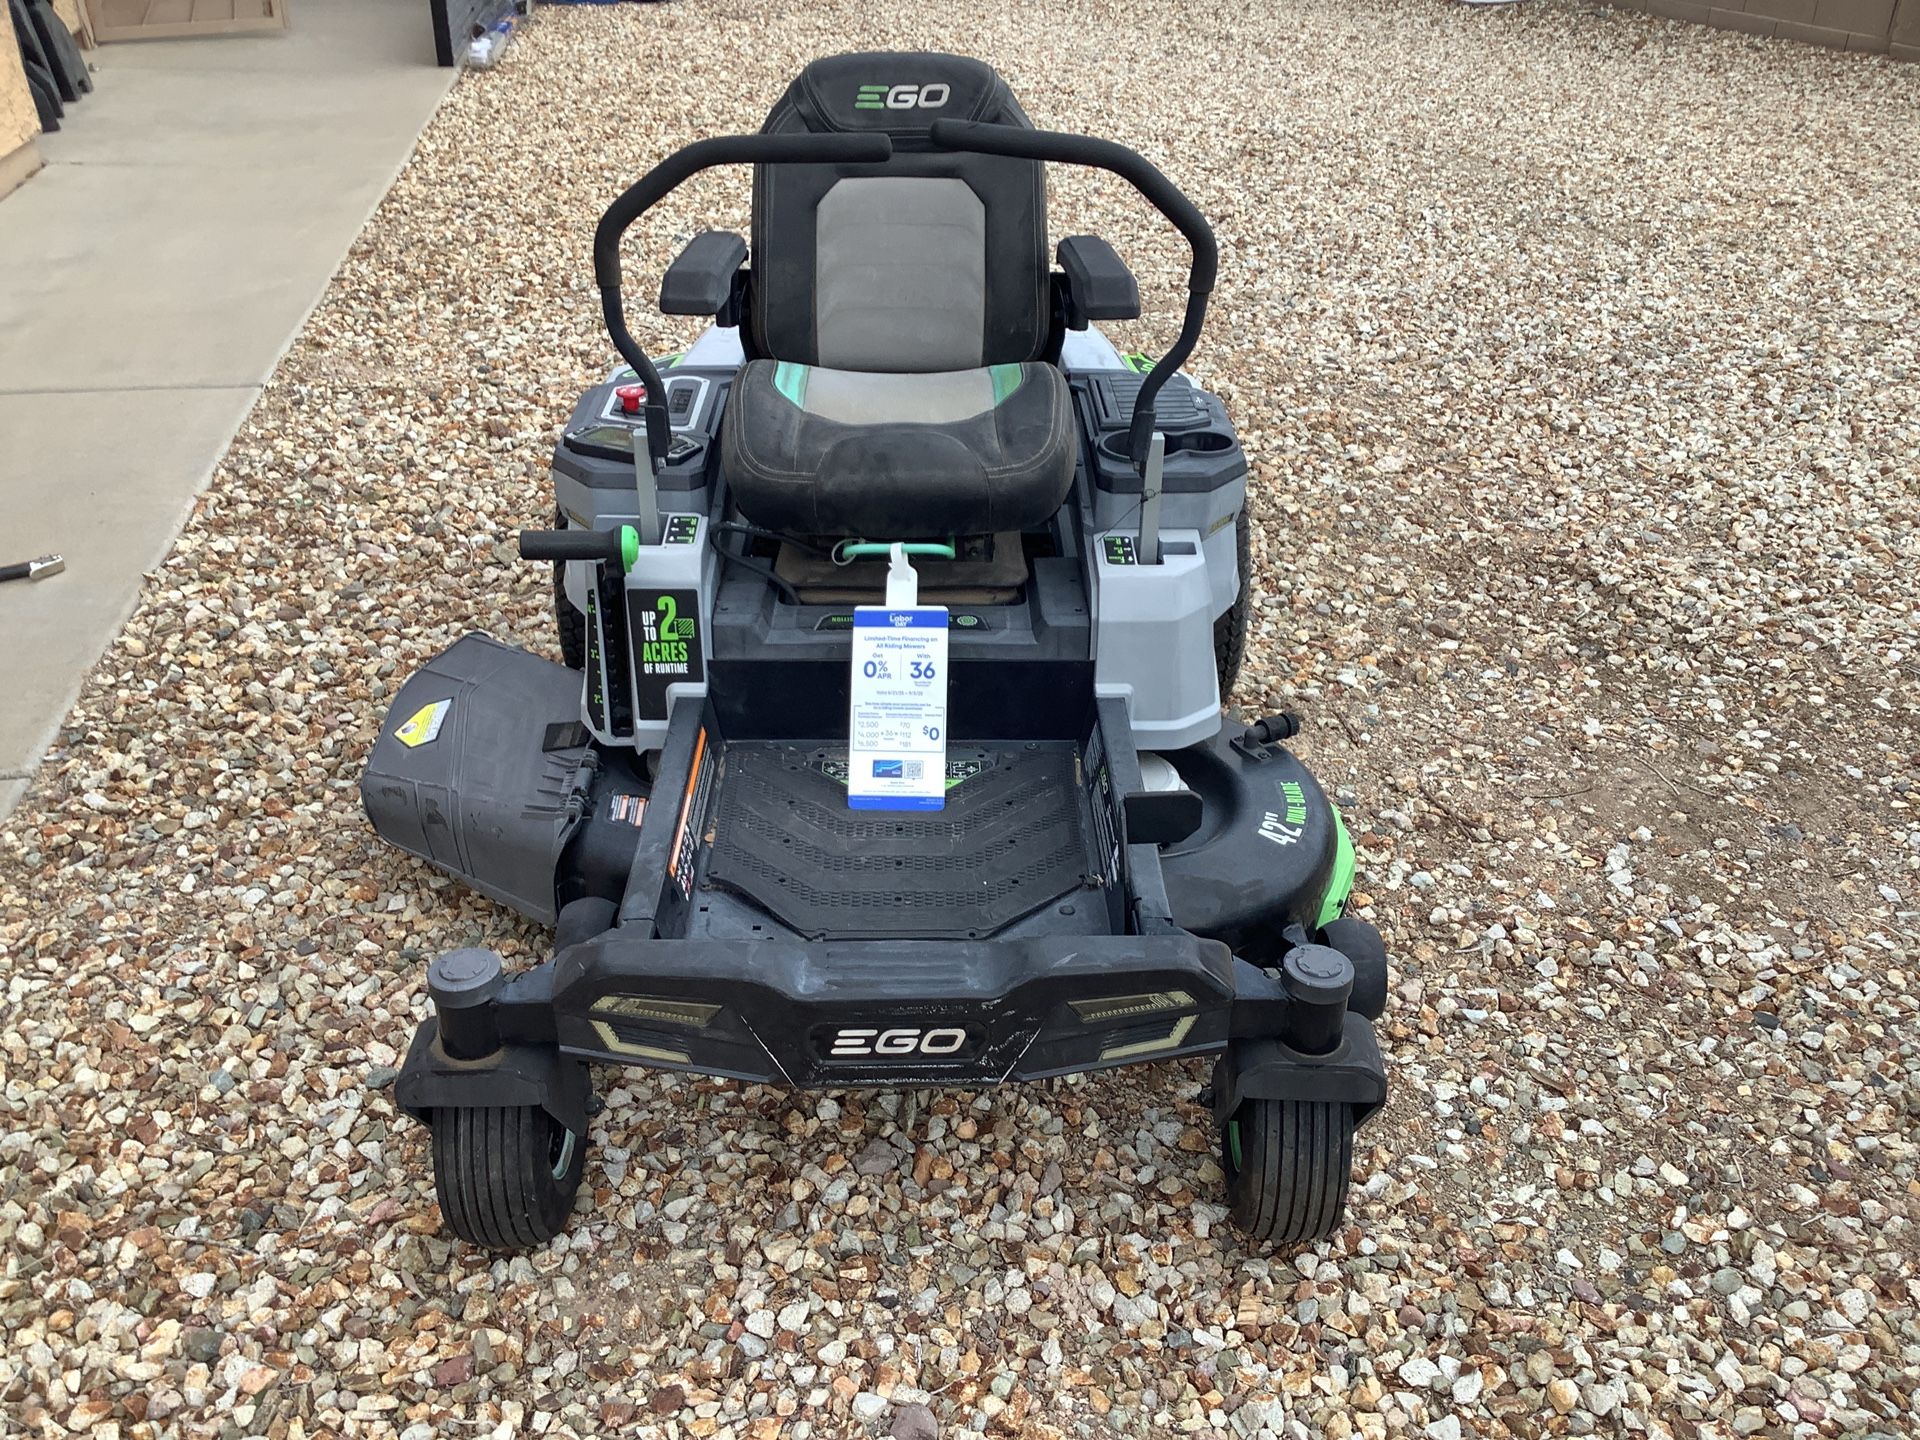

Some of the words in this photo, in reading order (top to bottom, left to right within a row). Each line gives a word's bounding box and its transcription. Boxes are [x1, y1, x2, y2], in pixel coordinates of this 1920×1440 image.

[854, 82, 951, 110] EGO
[642, 611, 656, 626] UP
[657, 595, 679, 641] 2
[889, 612, 913, 623] Labor
[643, 626, 657, 641] TO
[642, 642, 688, 662] ACRES
[644, 663, 654, 674] OF
[655, 663, 689, 674] RUNTIME
[910, 661, 936, 680] 36
[922, 725, 940, 741] $0
[830, 1028, 967, 1055] EGO
